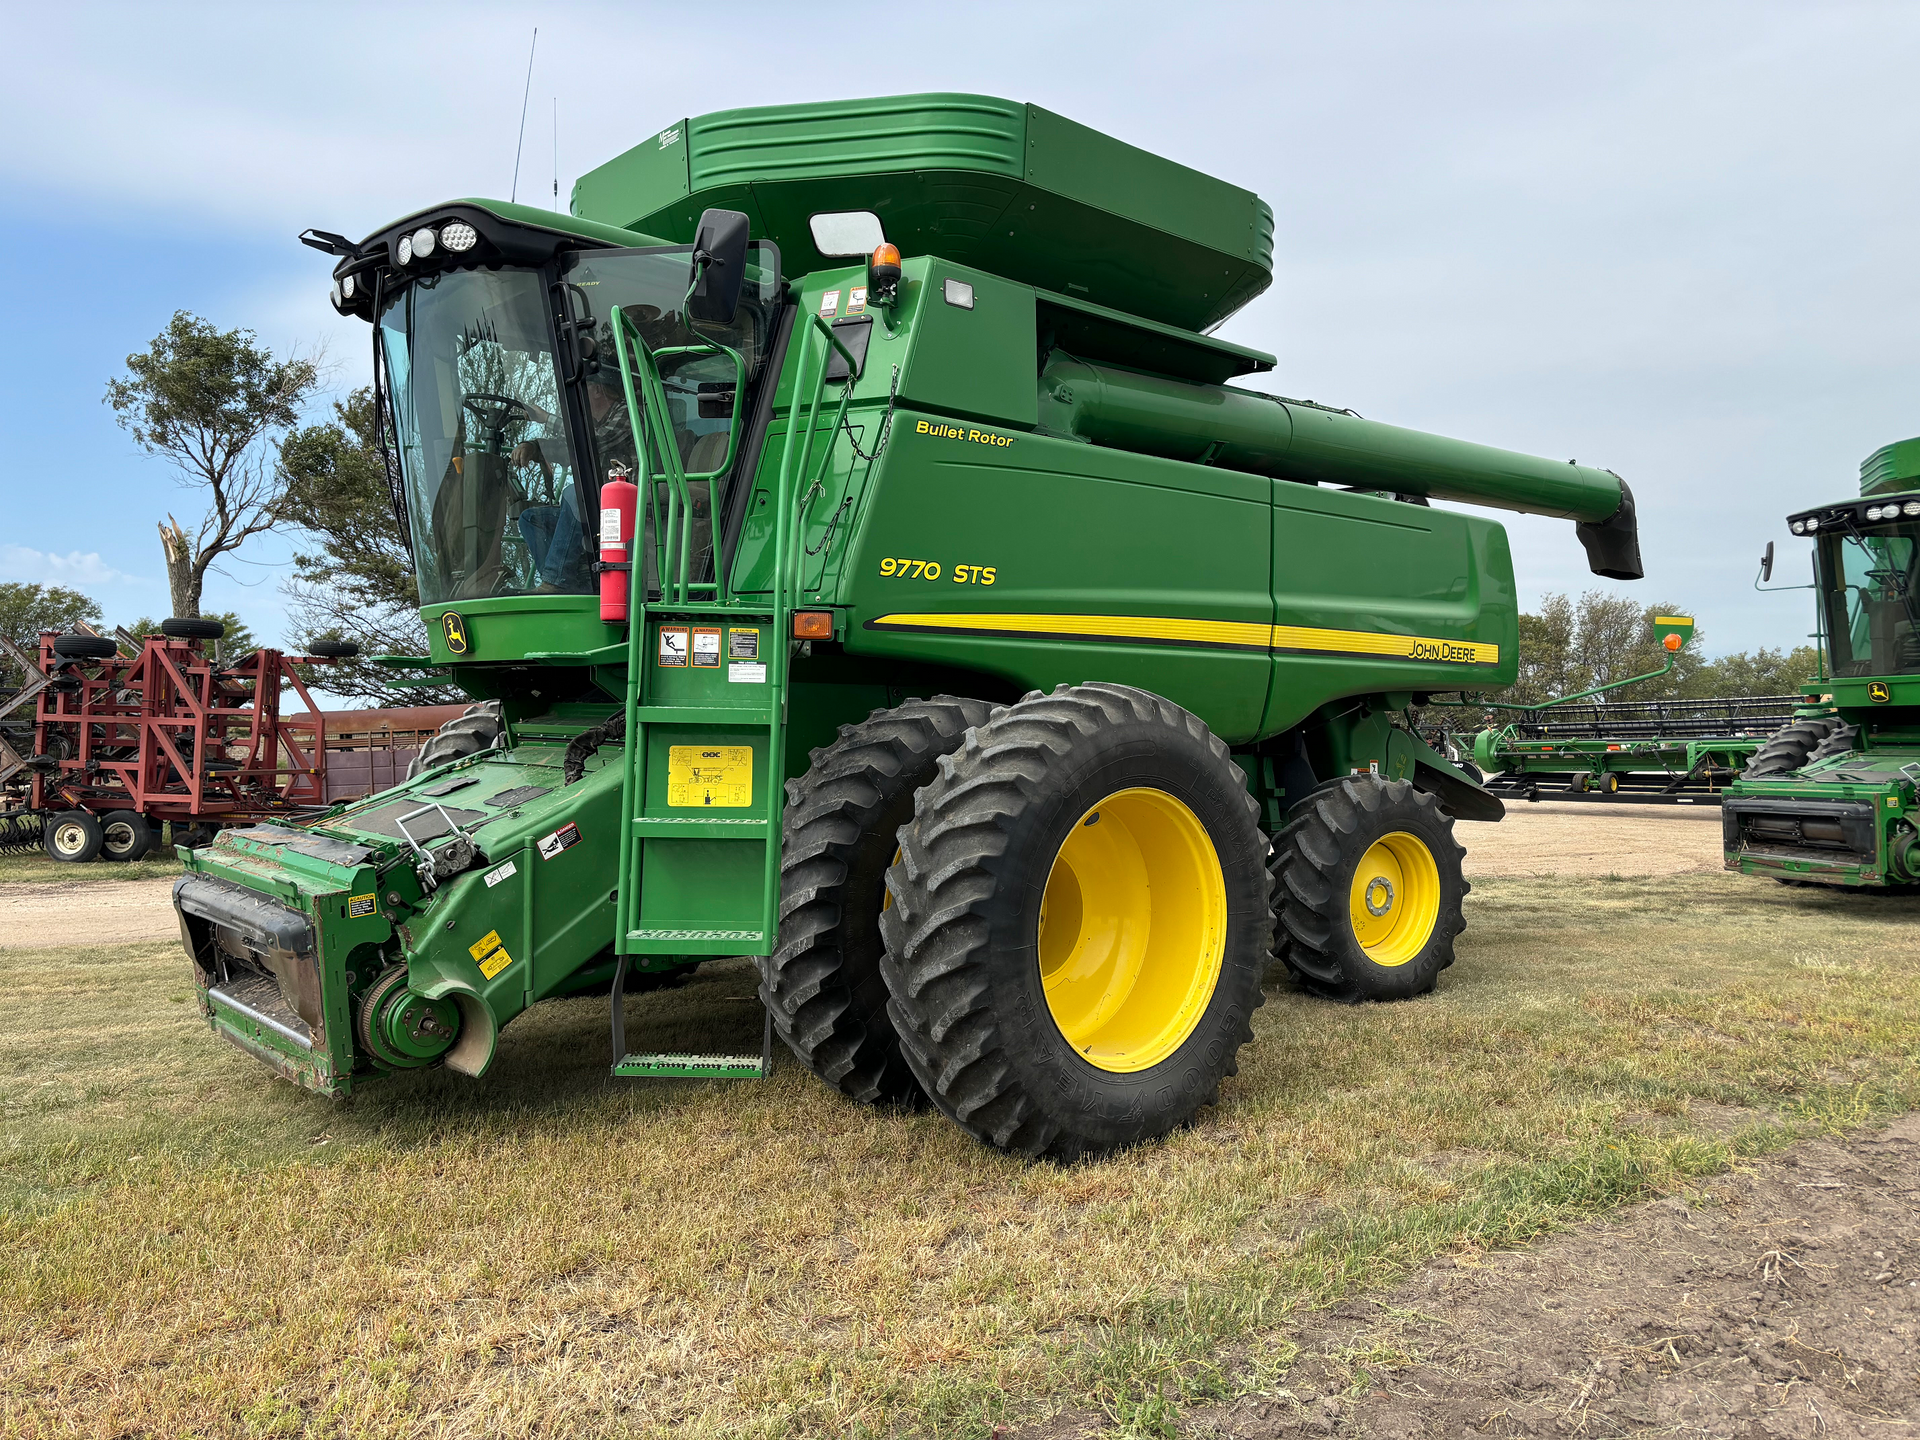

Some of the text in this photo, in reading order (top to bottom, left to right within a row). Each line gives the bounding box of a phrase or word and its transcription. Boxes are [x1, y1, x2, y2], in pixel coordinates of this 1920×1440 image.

[915, 420, 1014, 448] Bullet Rotor
[879, 557, 997, 586] 9770 STS
[1408, 640, 1476, 661] JOHN DEERE
[353, 894, 374, 902] CAUTION
